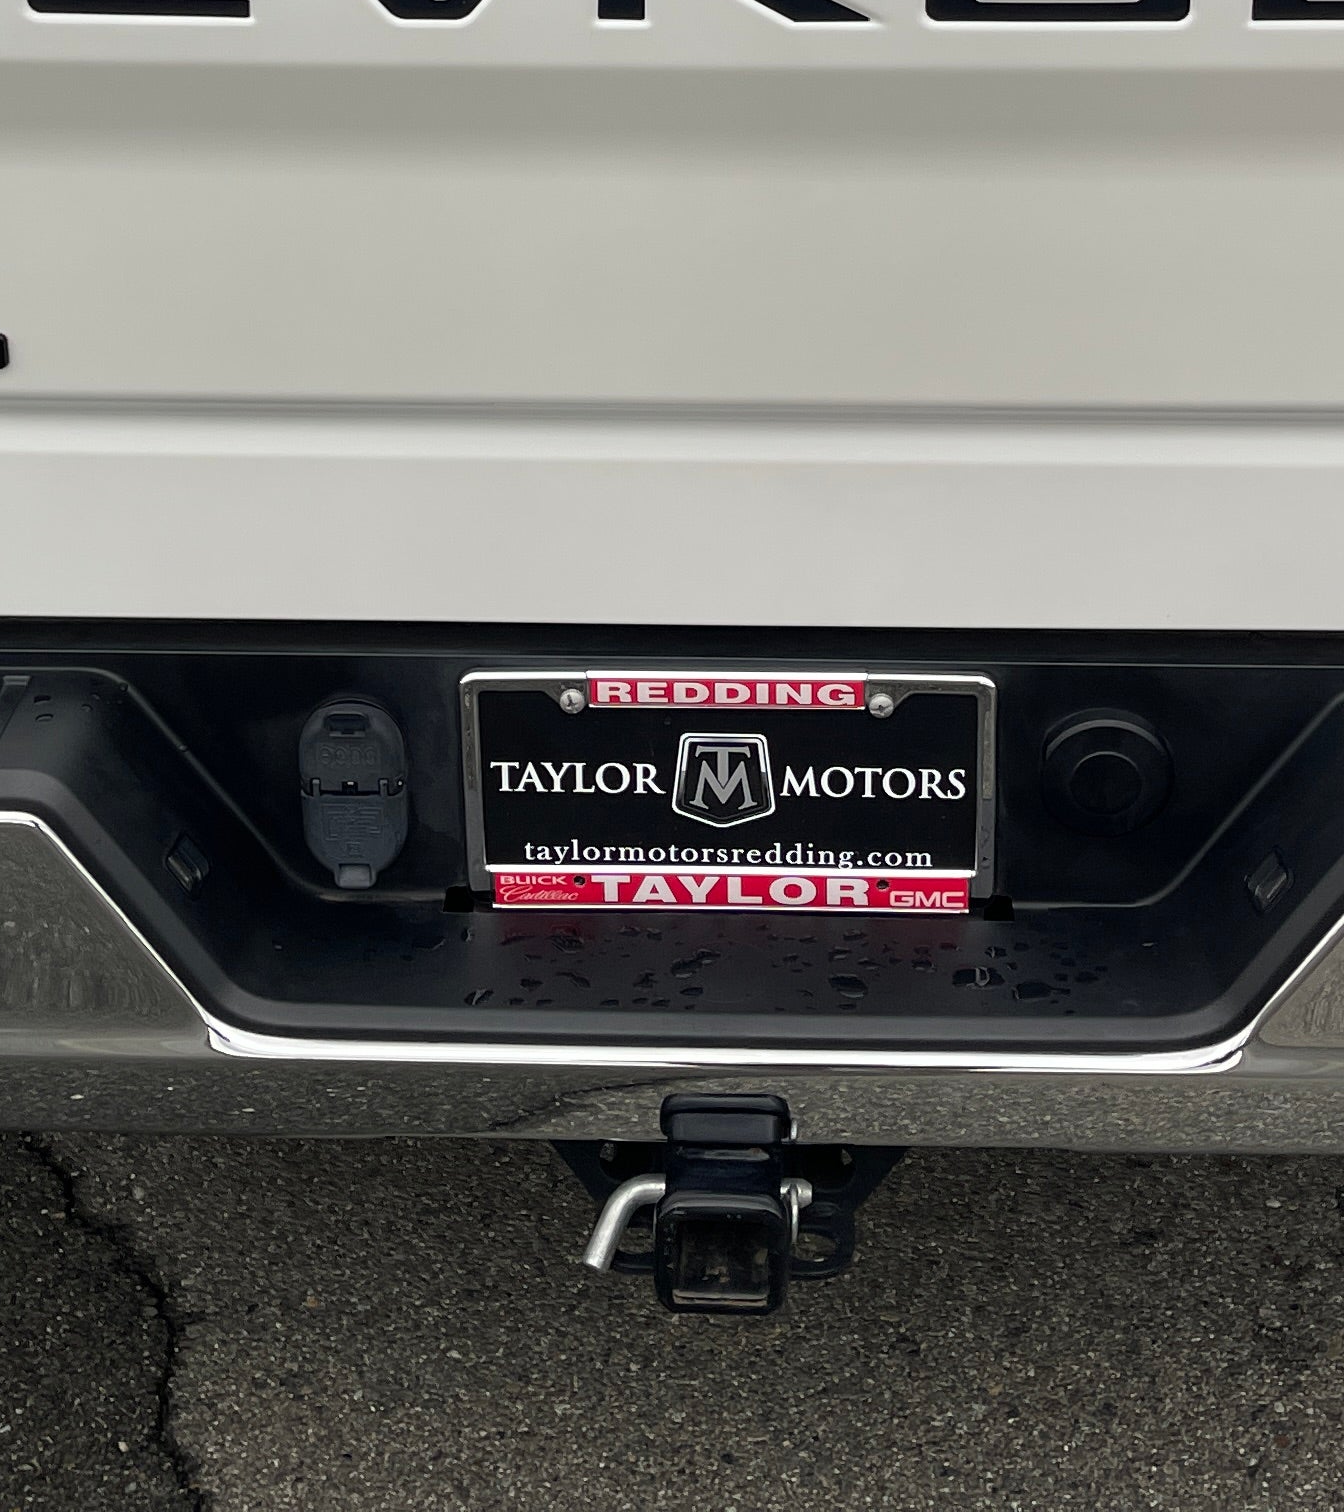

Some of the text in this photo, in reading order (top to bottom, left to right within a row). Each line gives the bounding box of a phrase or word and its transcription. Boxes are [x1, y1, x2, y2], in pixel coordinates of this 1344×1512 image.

[596, 681, 856, 706] REDDING
[489, 761, 667, 795] TAYLOR
[779, 765, 967, 800] MOTORS
[523, 839, 933, 869] taylormotorsredding.com
[499, 885, 965, 909] Cadillac GMC
[500, 874, 871, 907] BUICK TAYLOR
